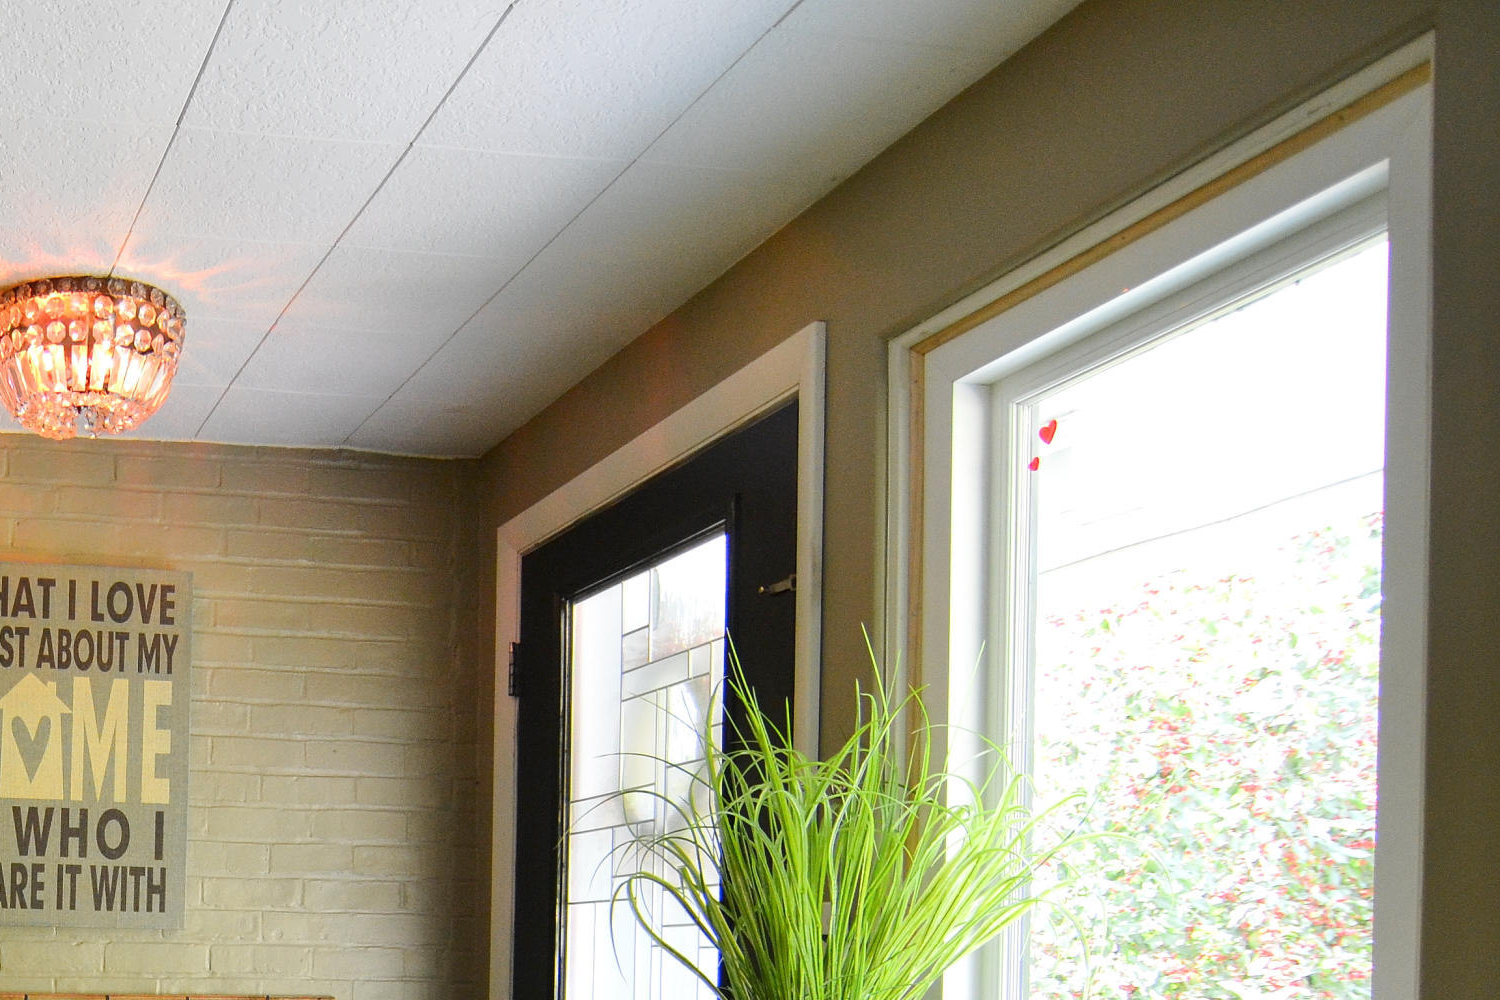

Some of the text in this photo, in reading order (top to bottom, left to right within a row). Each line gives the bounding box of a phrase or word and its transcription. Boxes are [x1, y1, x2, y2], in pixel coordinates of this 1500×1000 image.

[68, 579, 77, 621] I
[90, 581, 176, 625] LOVE
[36, 628, 129, 672] ABOUT
[137, 632, 179, 674] MY
[12, 806, 131, 860] WHO
[154, 810, 165, 861] I
[55, 863, 82, 911] IT
[90, 865, 167, 913] WITH
